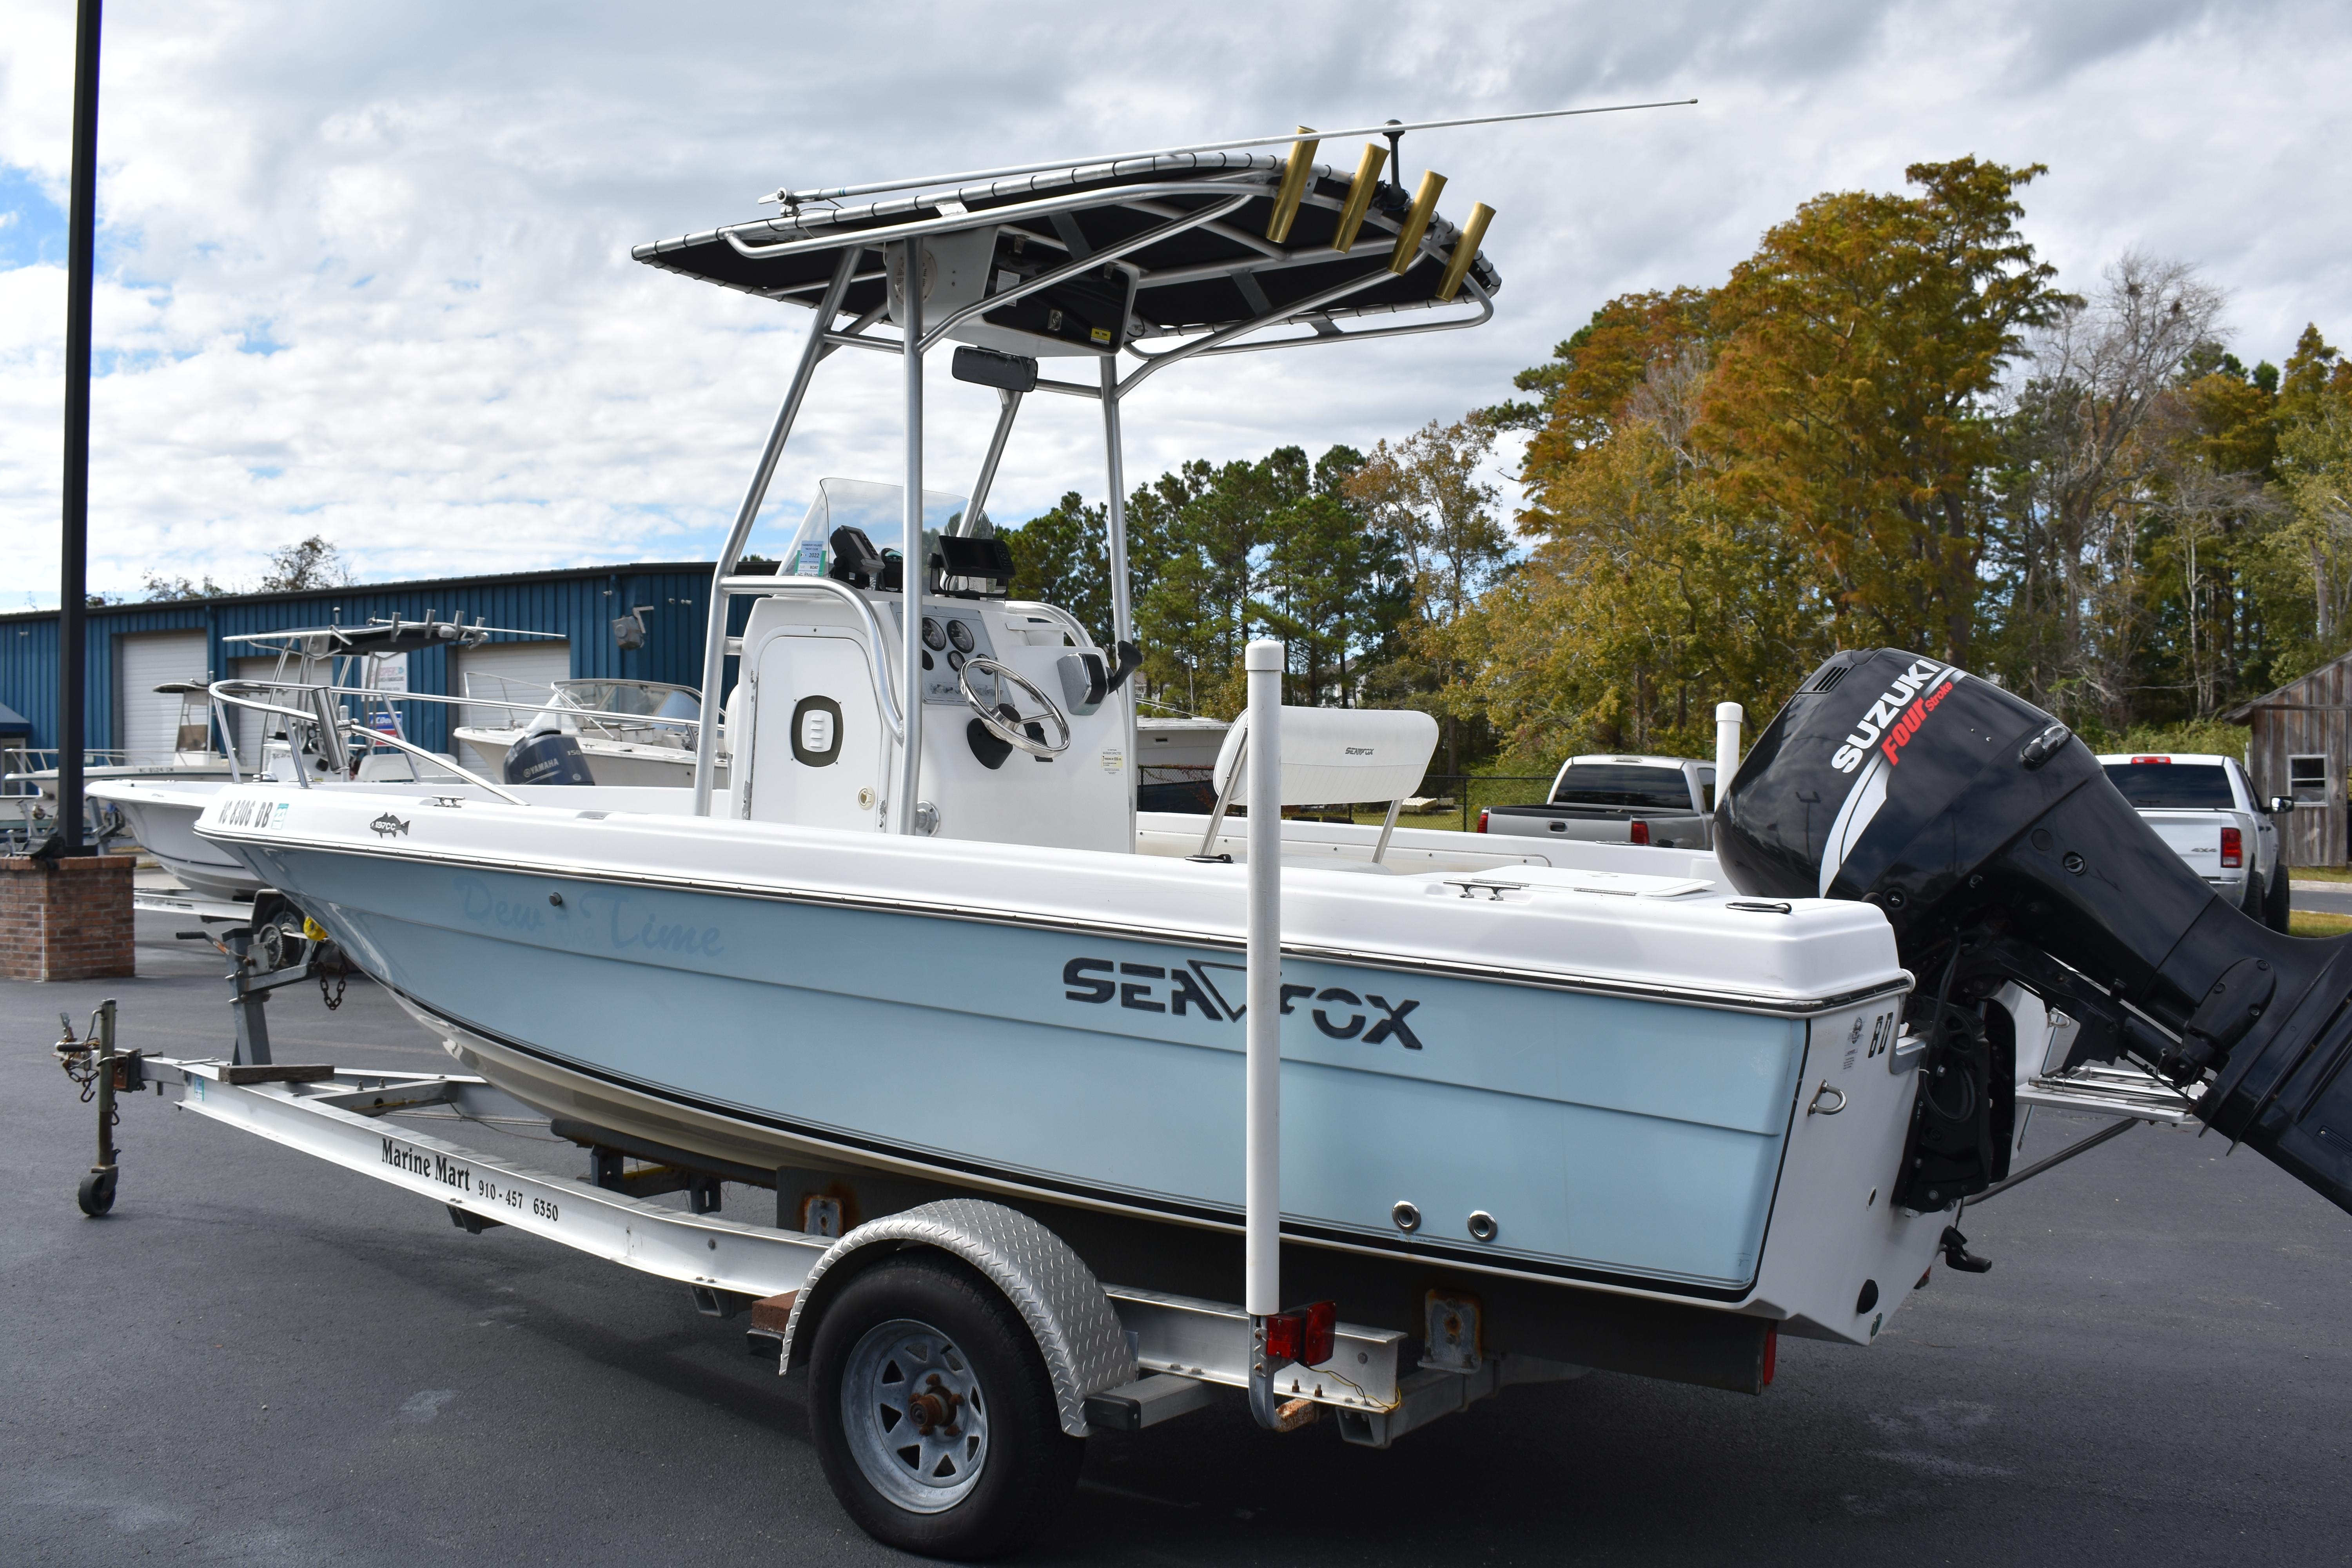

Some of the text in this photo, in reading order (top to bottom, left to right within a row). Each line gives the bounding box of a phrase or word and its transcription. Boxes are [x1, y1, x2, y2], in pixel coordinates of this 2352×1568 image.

[1925, 681, 1953, 712] Stroke
[1831, 659, 1941, 773] SUZUKI
[530, 758, 559, 775] YAMAHA
[229, 800, 256, 826] 8306
[254, 802, 273, 828] DB
[376, 821, 396, 831] 197CC
[382, 1138, 431, 1178] Marine
[435, 1154, 470, 1192] Mart
[478, 1180, 496, 1200] 910
[505, 1189, 523, 1209] 457
[533, 1198, 559, 1222] 6350
